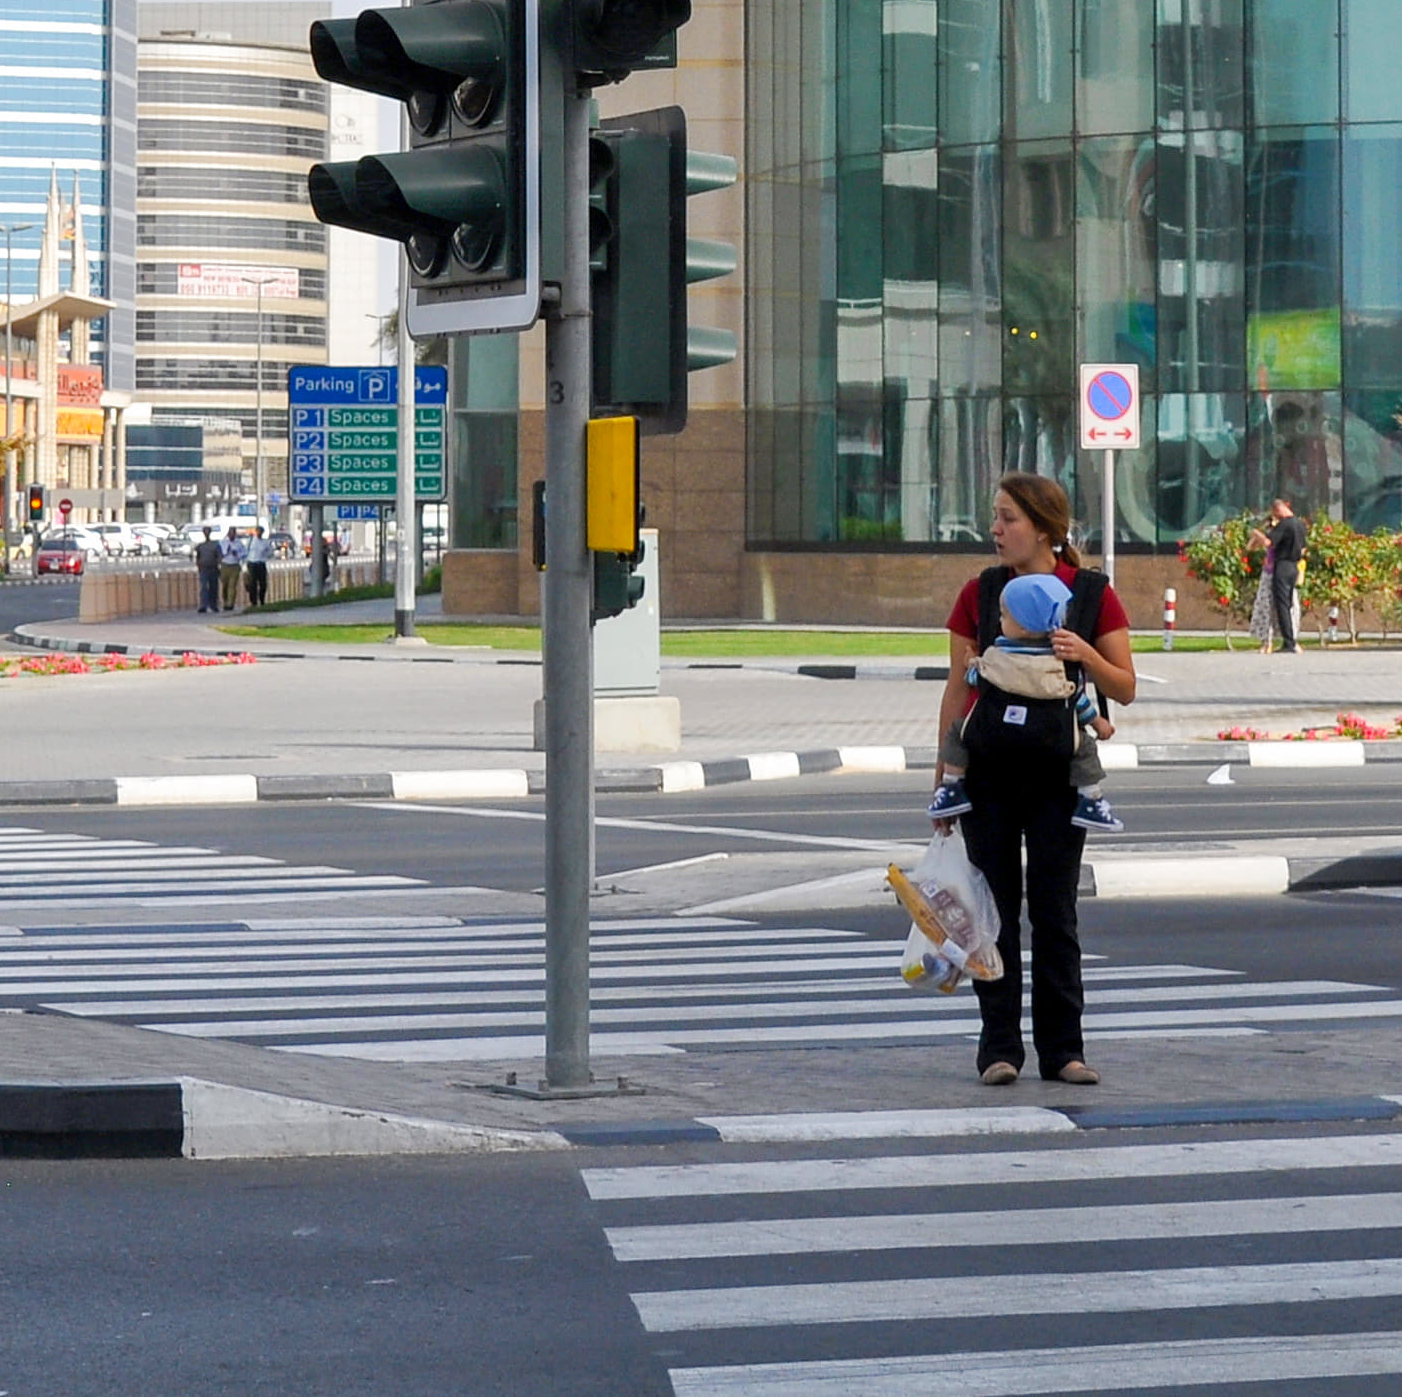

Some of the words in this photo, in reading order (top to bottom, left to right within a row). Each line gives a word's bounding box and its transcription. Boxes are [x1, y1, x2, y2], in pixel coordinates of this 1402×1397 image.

[295, 377, 355, 394] Parking
[330, 409, 389, 425] Spaces
[296, 433, 323, 450] P2
[330, 432, 389, 448] Spaces
[296, 456, 323, 473] P3
[330, 455, 389, 471] Spaces
[296, 478, 323, 494] P4
[330, 478, 389, 492] Spaces
